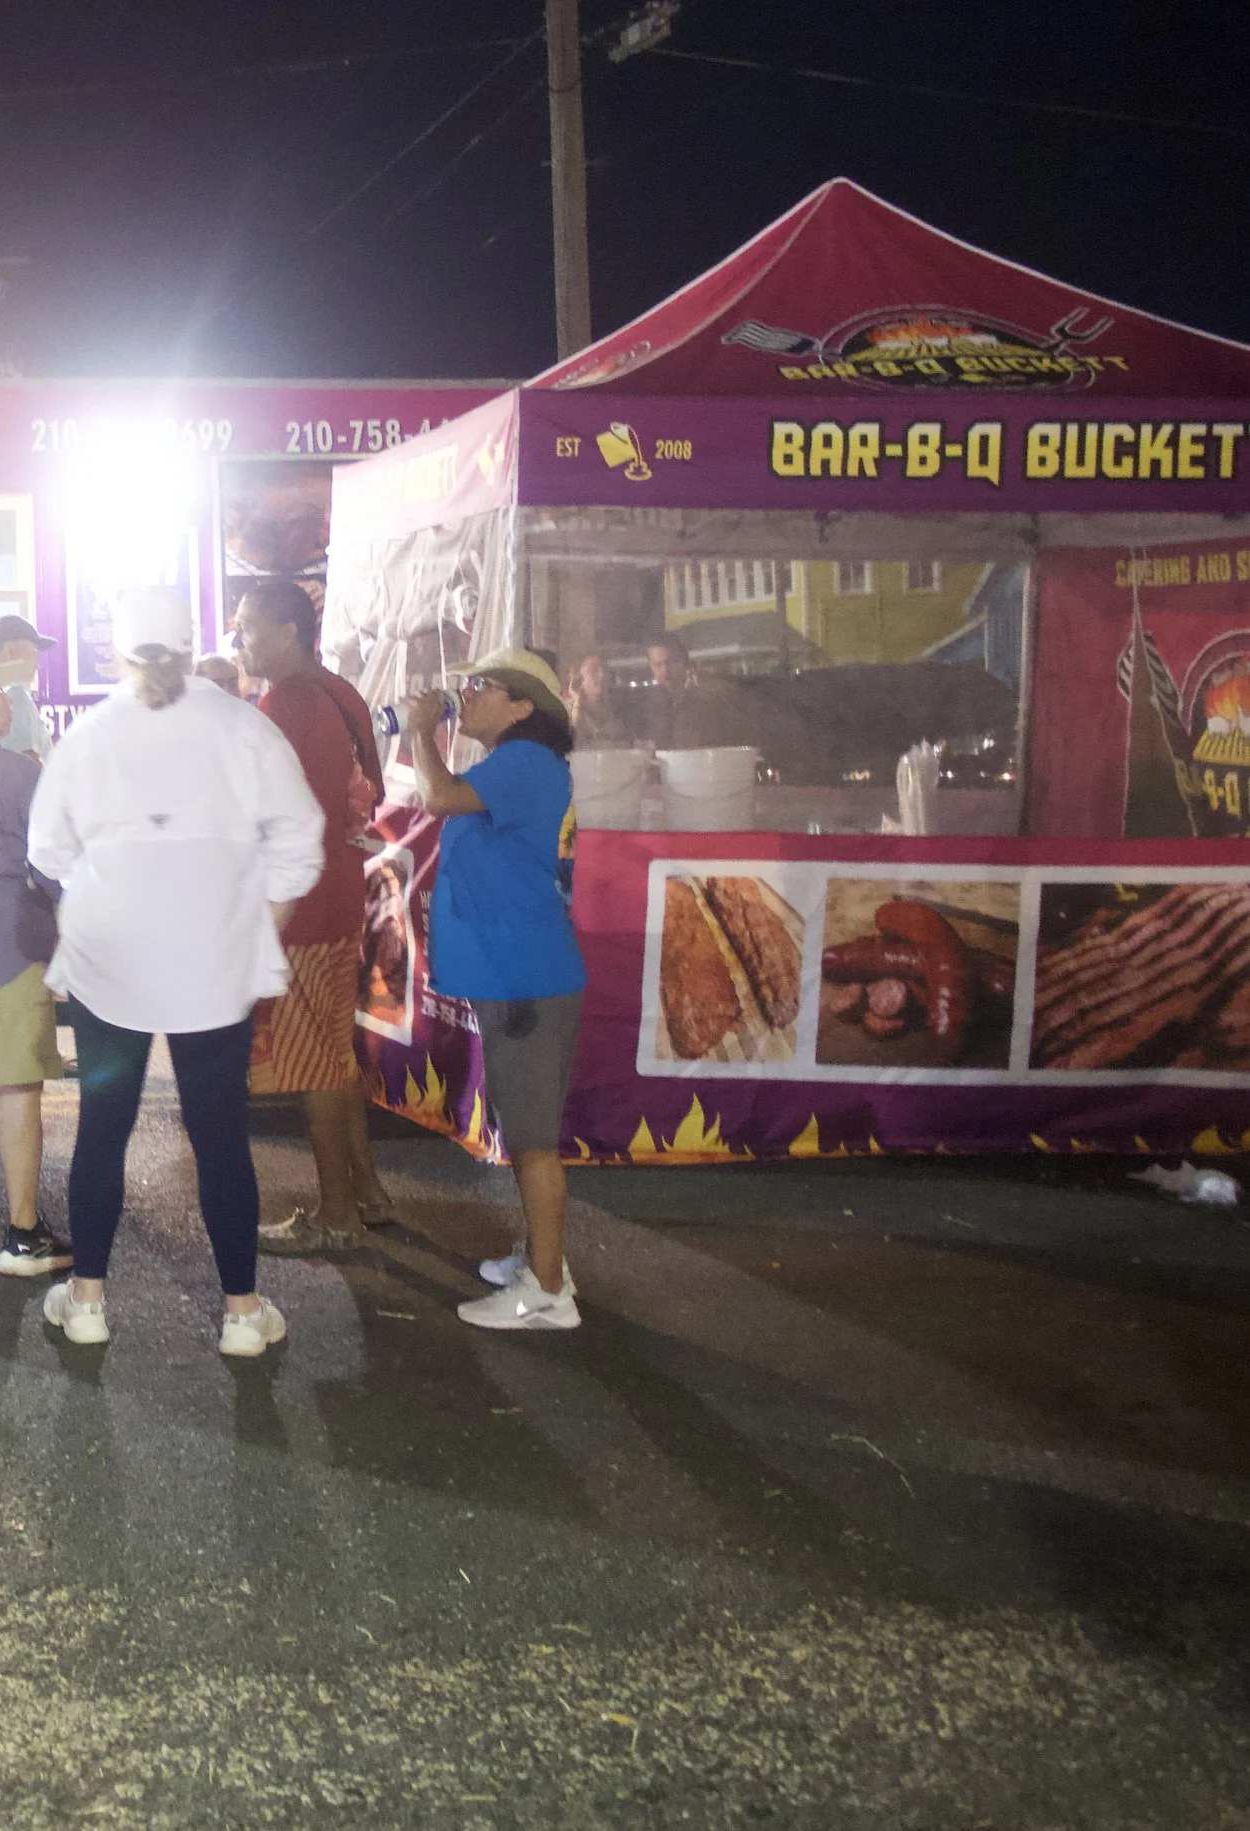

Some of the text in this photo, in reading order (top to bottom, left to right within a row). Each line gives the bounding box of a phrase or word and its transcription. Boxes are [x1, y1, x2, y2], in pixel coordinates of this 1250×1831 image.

[556, 436, 582, 458] EST
[655, 438, 693, 461] 2008
[771, 422, 1250, 487] BAR-B-Q BUCKET
[1197, 552, 1232, 584] AND
